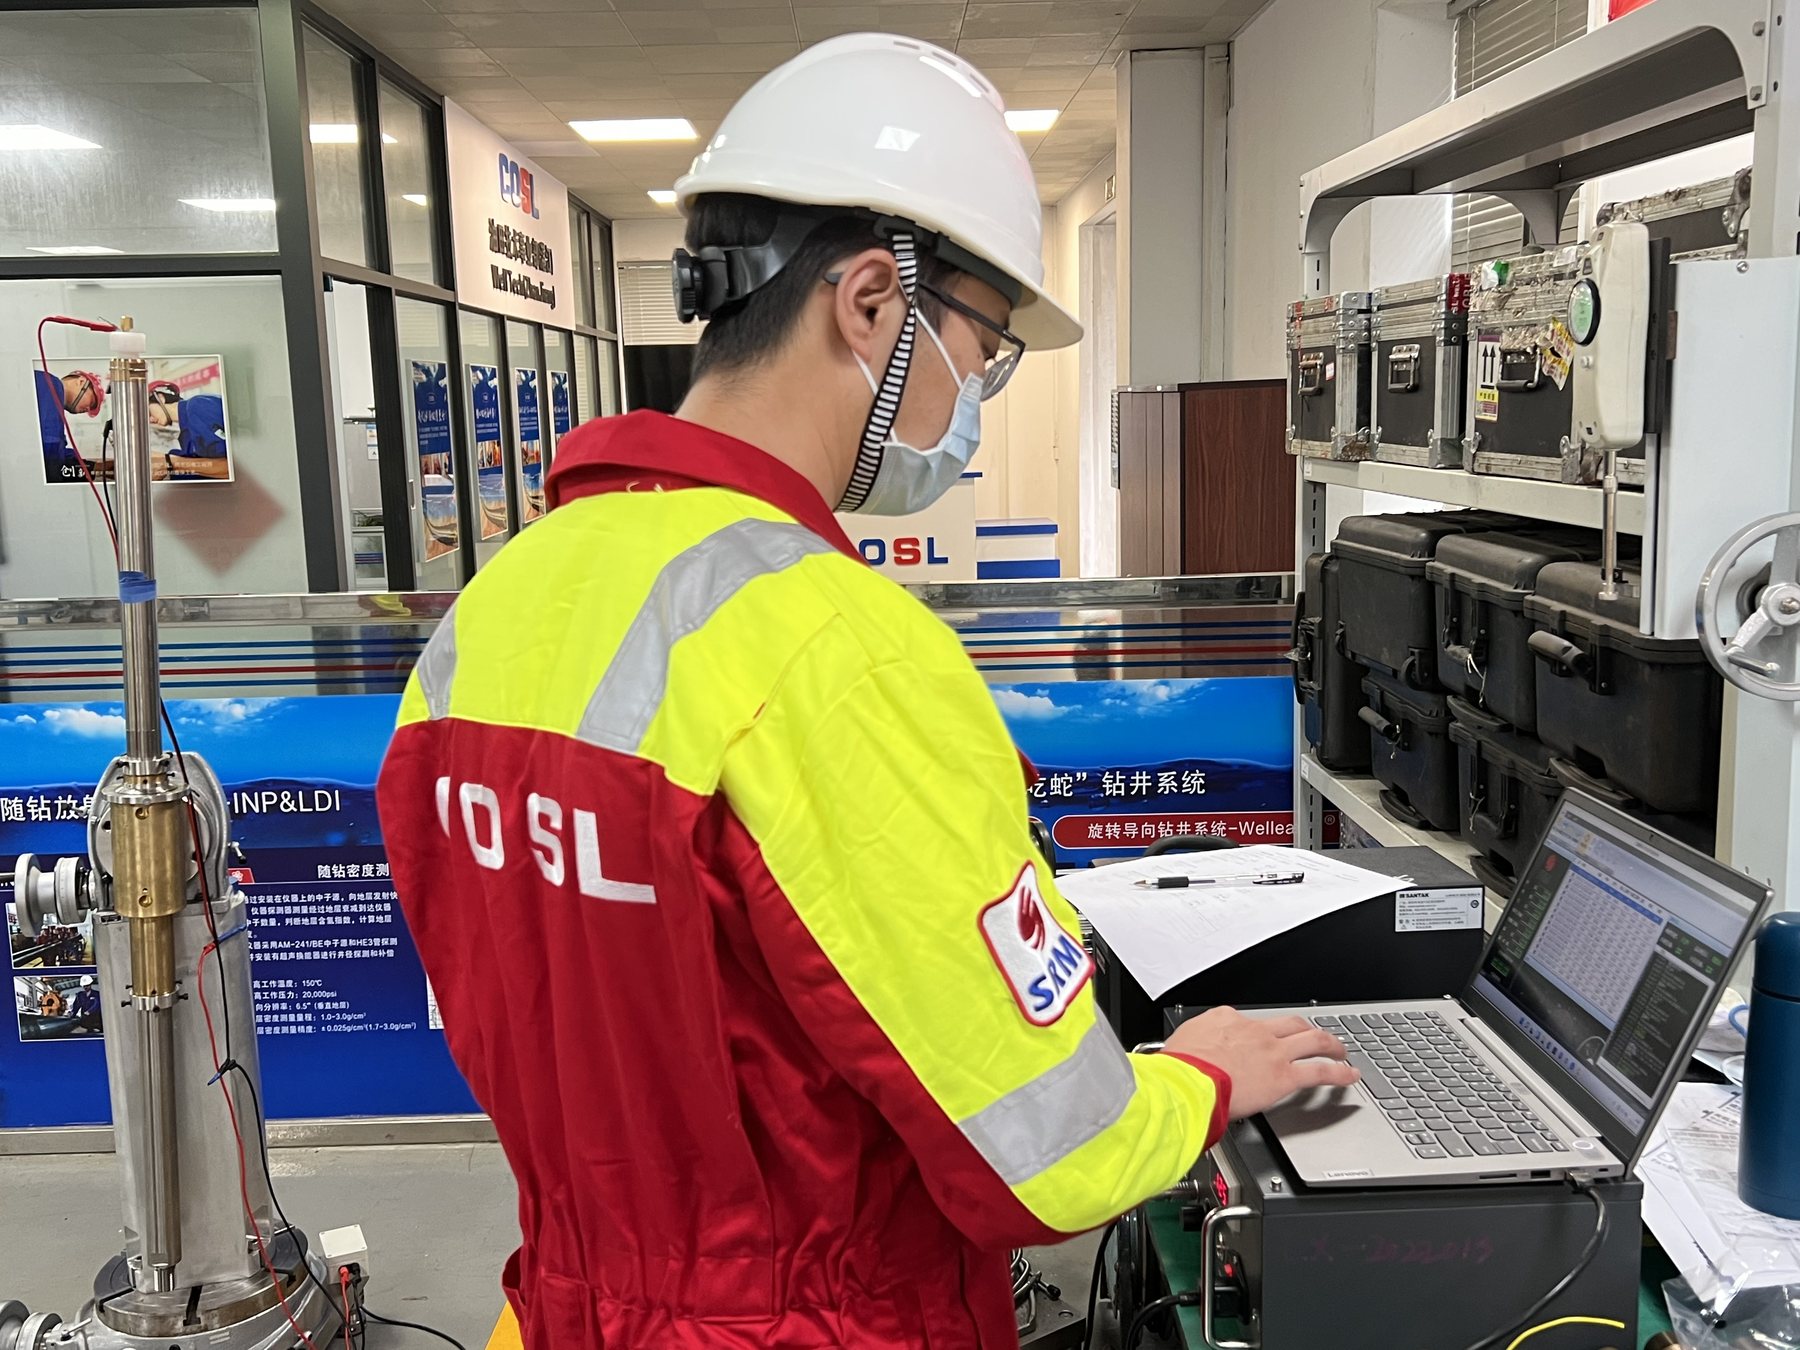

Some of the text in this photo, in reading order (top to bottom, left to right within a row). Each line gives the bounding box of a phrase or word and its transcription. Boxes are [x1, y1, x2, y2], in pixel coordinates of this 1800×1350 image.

[499, 153, 539, 220] COSL
[858, 536, 949, 566] OSL
[227, 789, 341, 814] INP&LDI
[317, 862, 390, 879] 随钻密度测
[1028, 934, 1083, 1012] SRM
[1327, 1170, 1369, 1178] Lenovo
